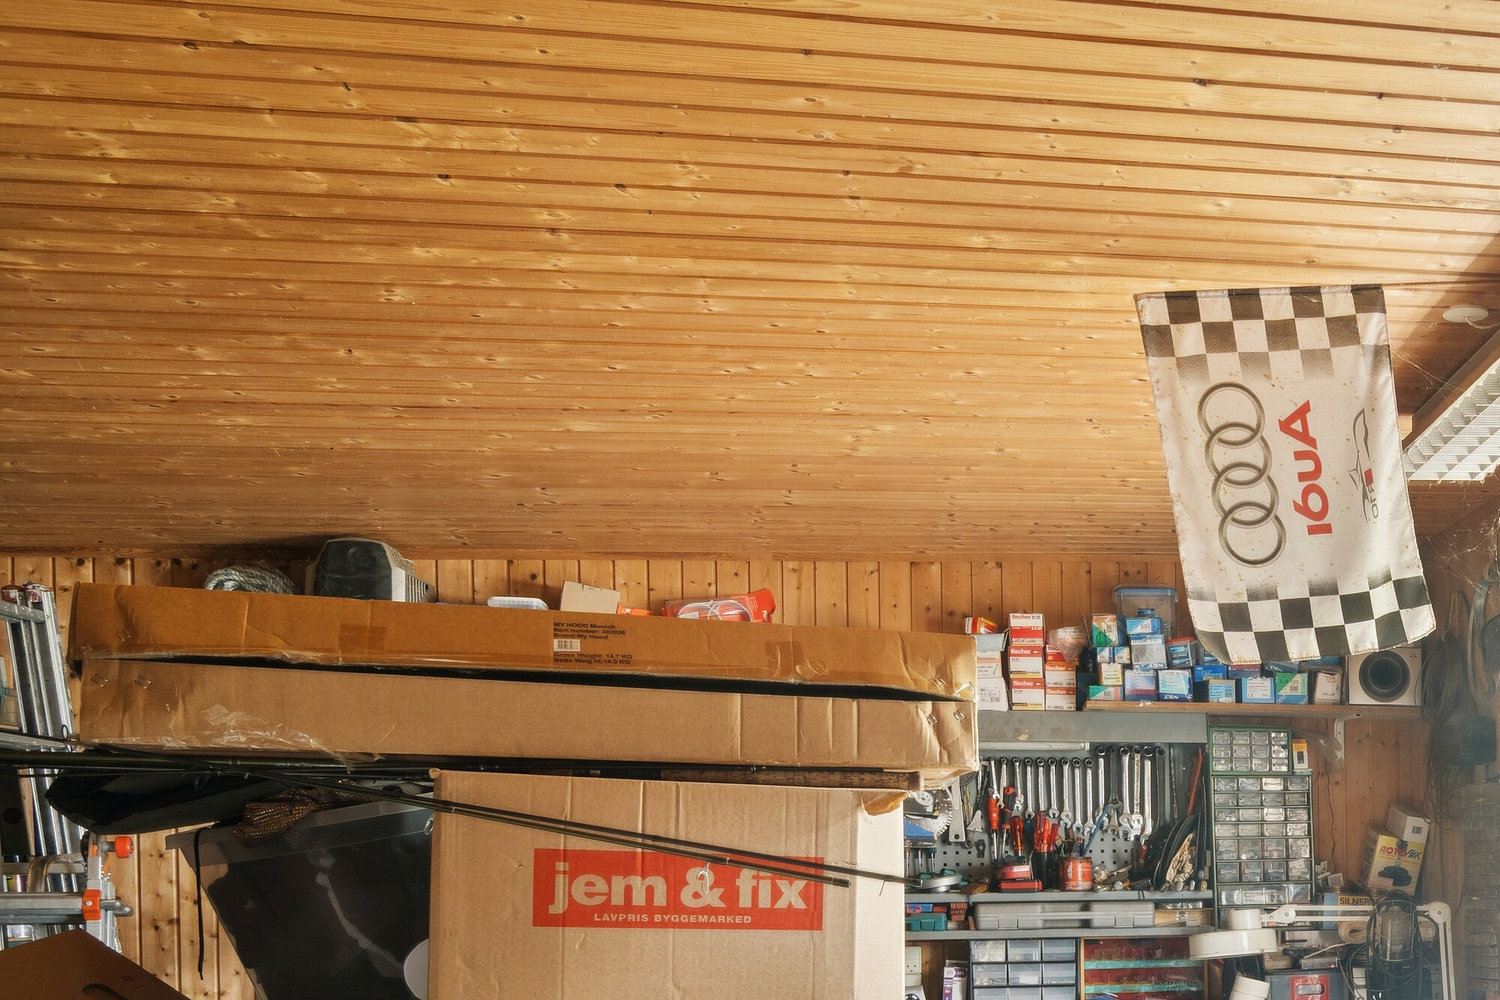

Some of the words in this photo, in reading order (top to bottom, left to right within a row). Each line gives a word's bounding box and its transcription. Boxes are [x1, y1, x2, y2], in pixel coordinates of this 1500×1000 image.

[549, 861, 667, 915] jem
[680, 867, 726, 909] &
[736, 867, 807, 910] fix
[594, 912, 648, 923] LAVPRIS
[653, 913, 752, 925] BYGGEMARKED
